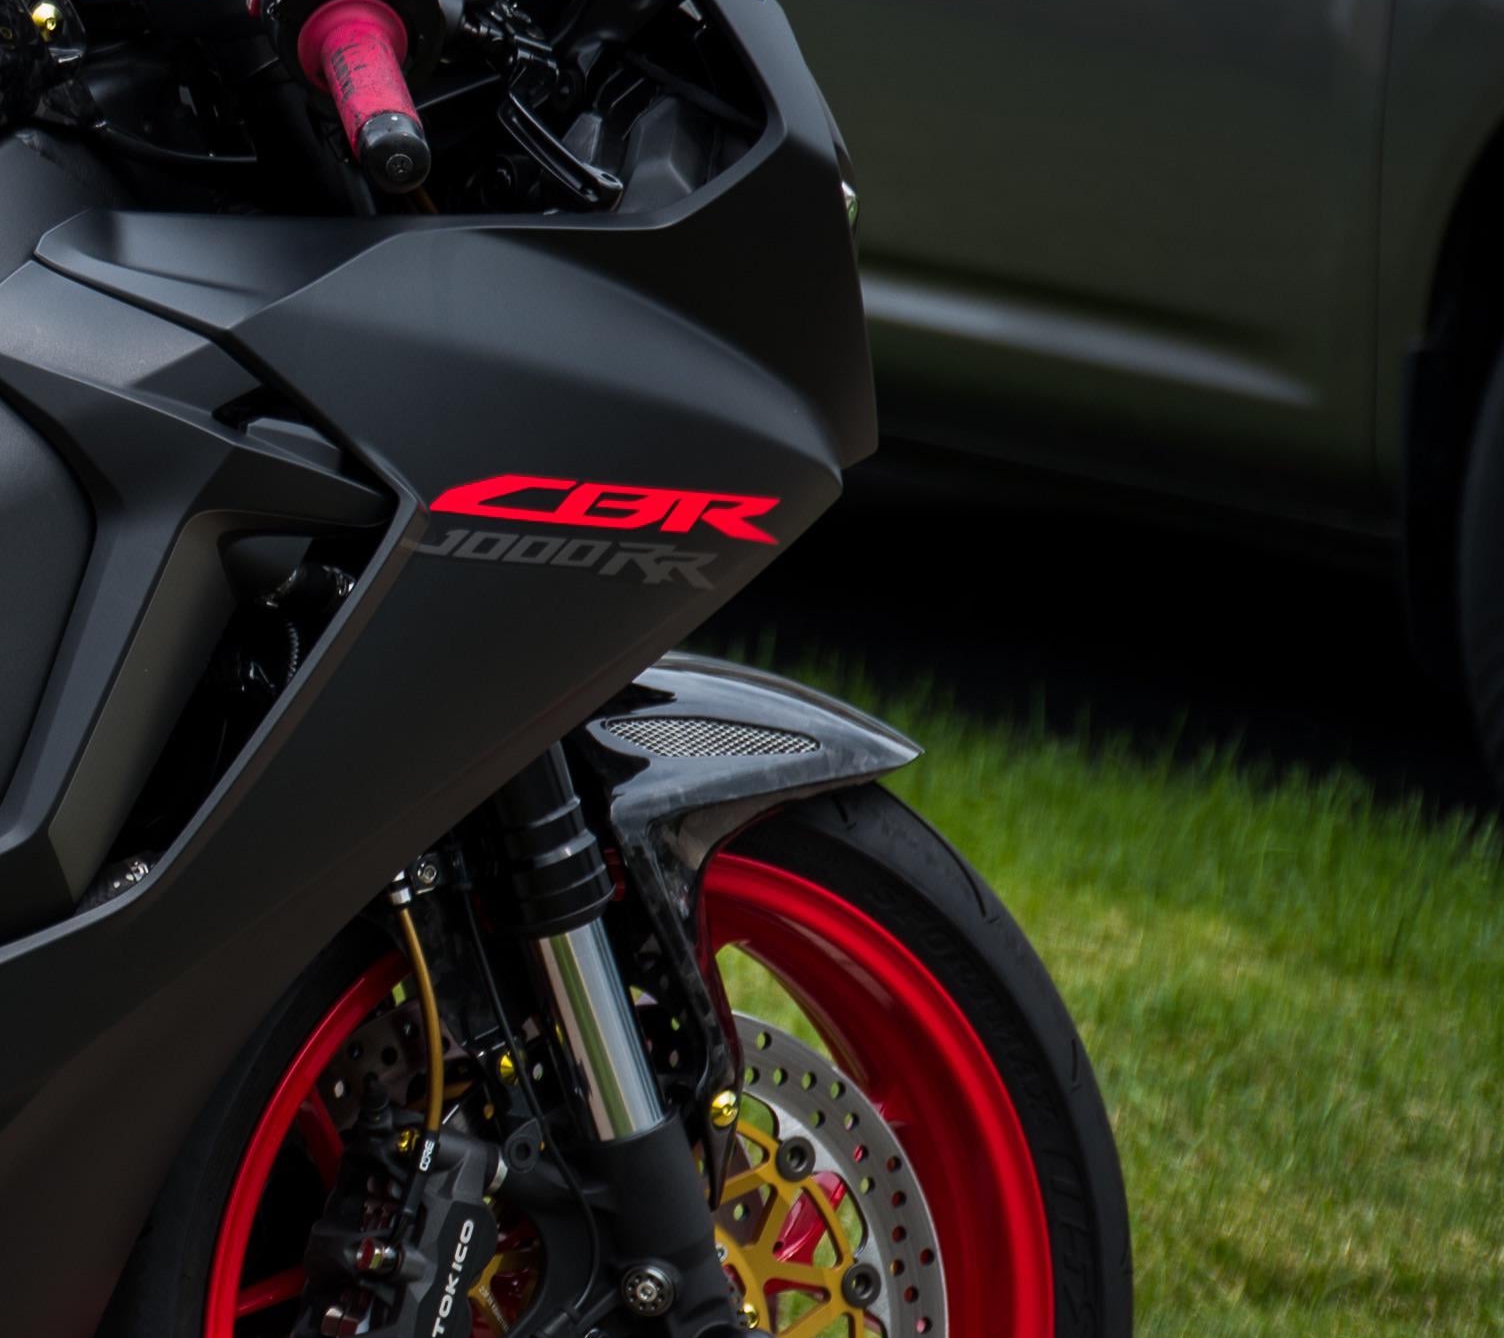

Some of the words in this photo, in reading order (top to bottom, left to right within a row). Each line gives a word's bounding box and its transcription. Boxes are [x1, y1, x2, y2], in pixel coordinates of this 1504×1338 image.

[430, 474, 780, 545] CBR
[420, 529, 716, 590] 1000RR
[431, 1218, 475, 1338] TOKICO
